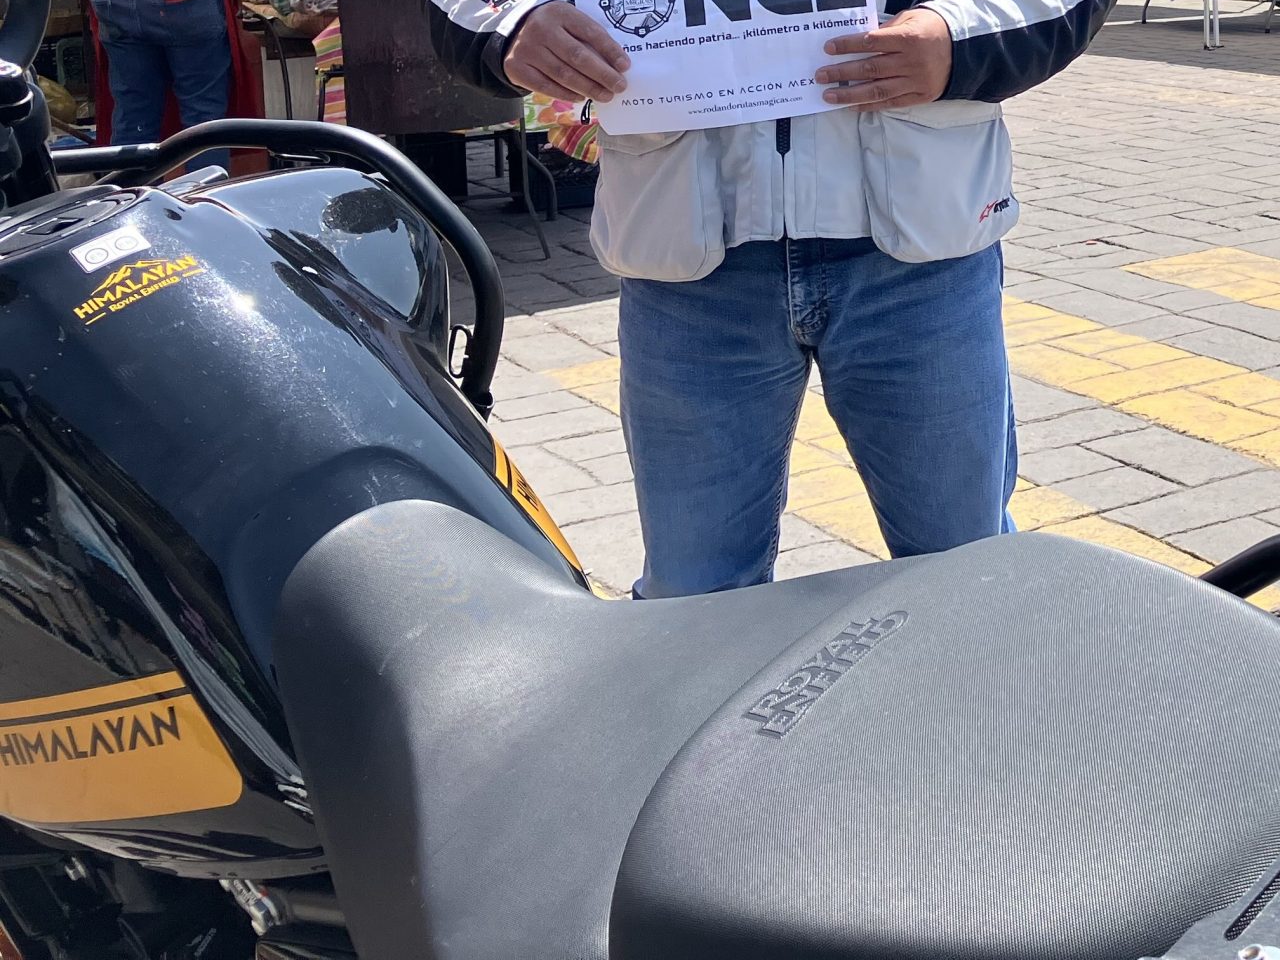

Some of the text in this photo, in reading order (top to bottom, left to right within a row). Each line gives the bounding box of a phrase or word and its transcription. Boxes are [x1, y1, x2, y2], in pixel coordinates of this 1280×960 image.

[622, 43, 643, 53] ños
[645, 36, 696, 50] haciendo
[742, 24, 800, 40] ¡kilómetro
[803, 23, 810, 31] a
[812, 16, 869, 30] kilómetro!
[621, 77, 815, 107] MOTO TURISMO EN ACCIÓN MEX
[687, 96, 804, 115] www.rodandorutasmagicas.com
[73, 254, 198, 319] HIMALAYAN
[108, 275, 181, 312] ROYAL ENFIELD
[741, 617, 882, 722] ROYAL
[756, 610, 910, 739] ENFIELD
[0, 705, 181, 766] HIMALAYAN
